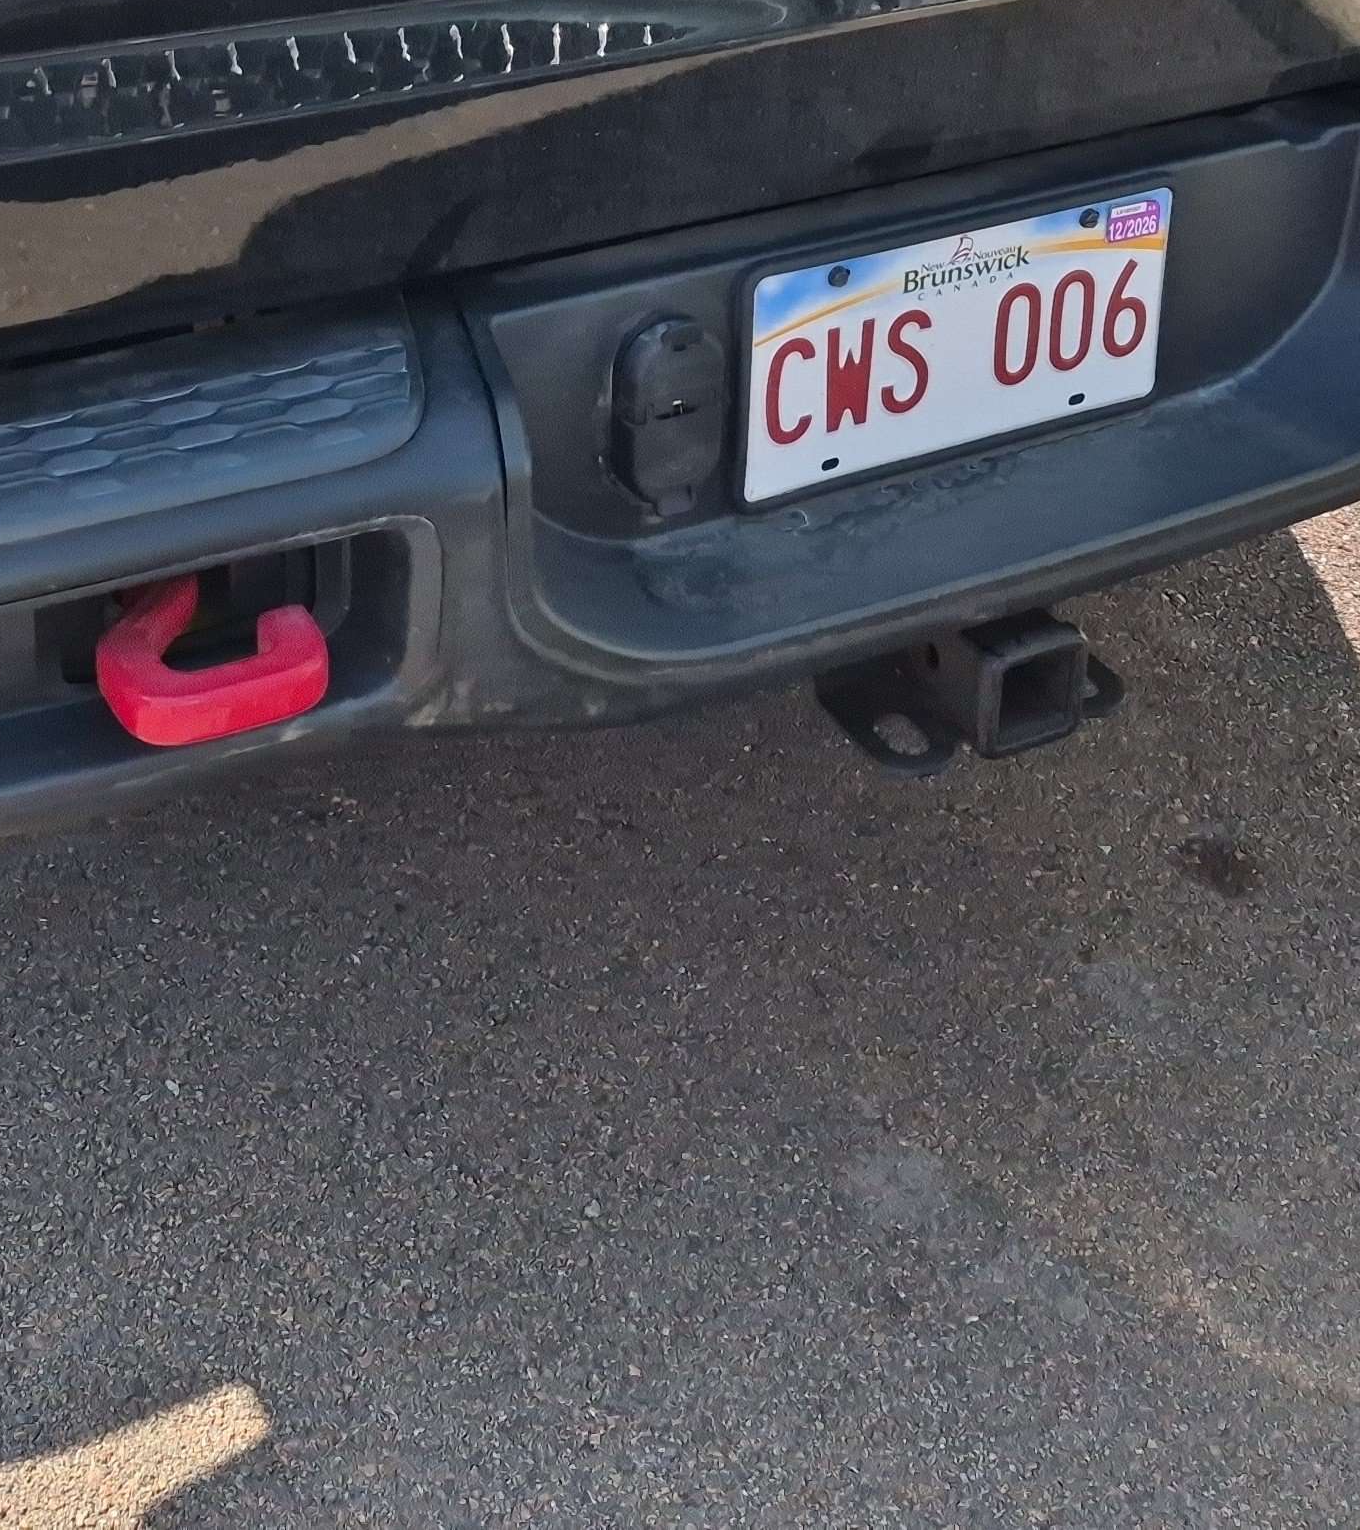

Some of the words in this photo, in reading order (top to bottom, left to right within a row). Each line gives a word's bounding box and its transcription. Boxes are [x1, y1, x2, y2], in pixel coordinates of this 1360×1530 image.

[1109, 215, 1157, 241] 12/2026
[903, 245, 1030, 294] Brunswick
[921, 261, 945, 273] New
[973, 246, 1016, 261] Nouveau
[918, 272, 1013, 301] CANADA
[765, 309, 932, 445] CWS
[993, 258, 1148, 387] 006
